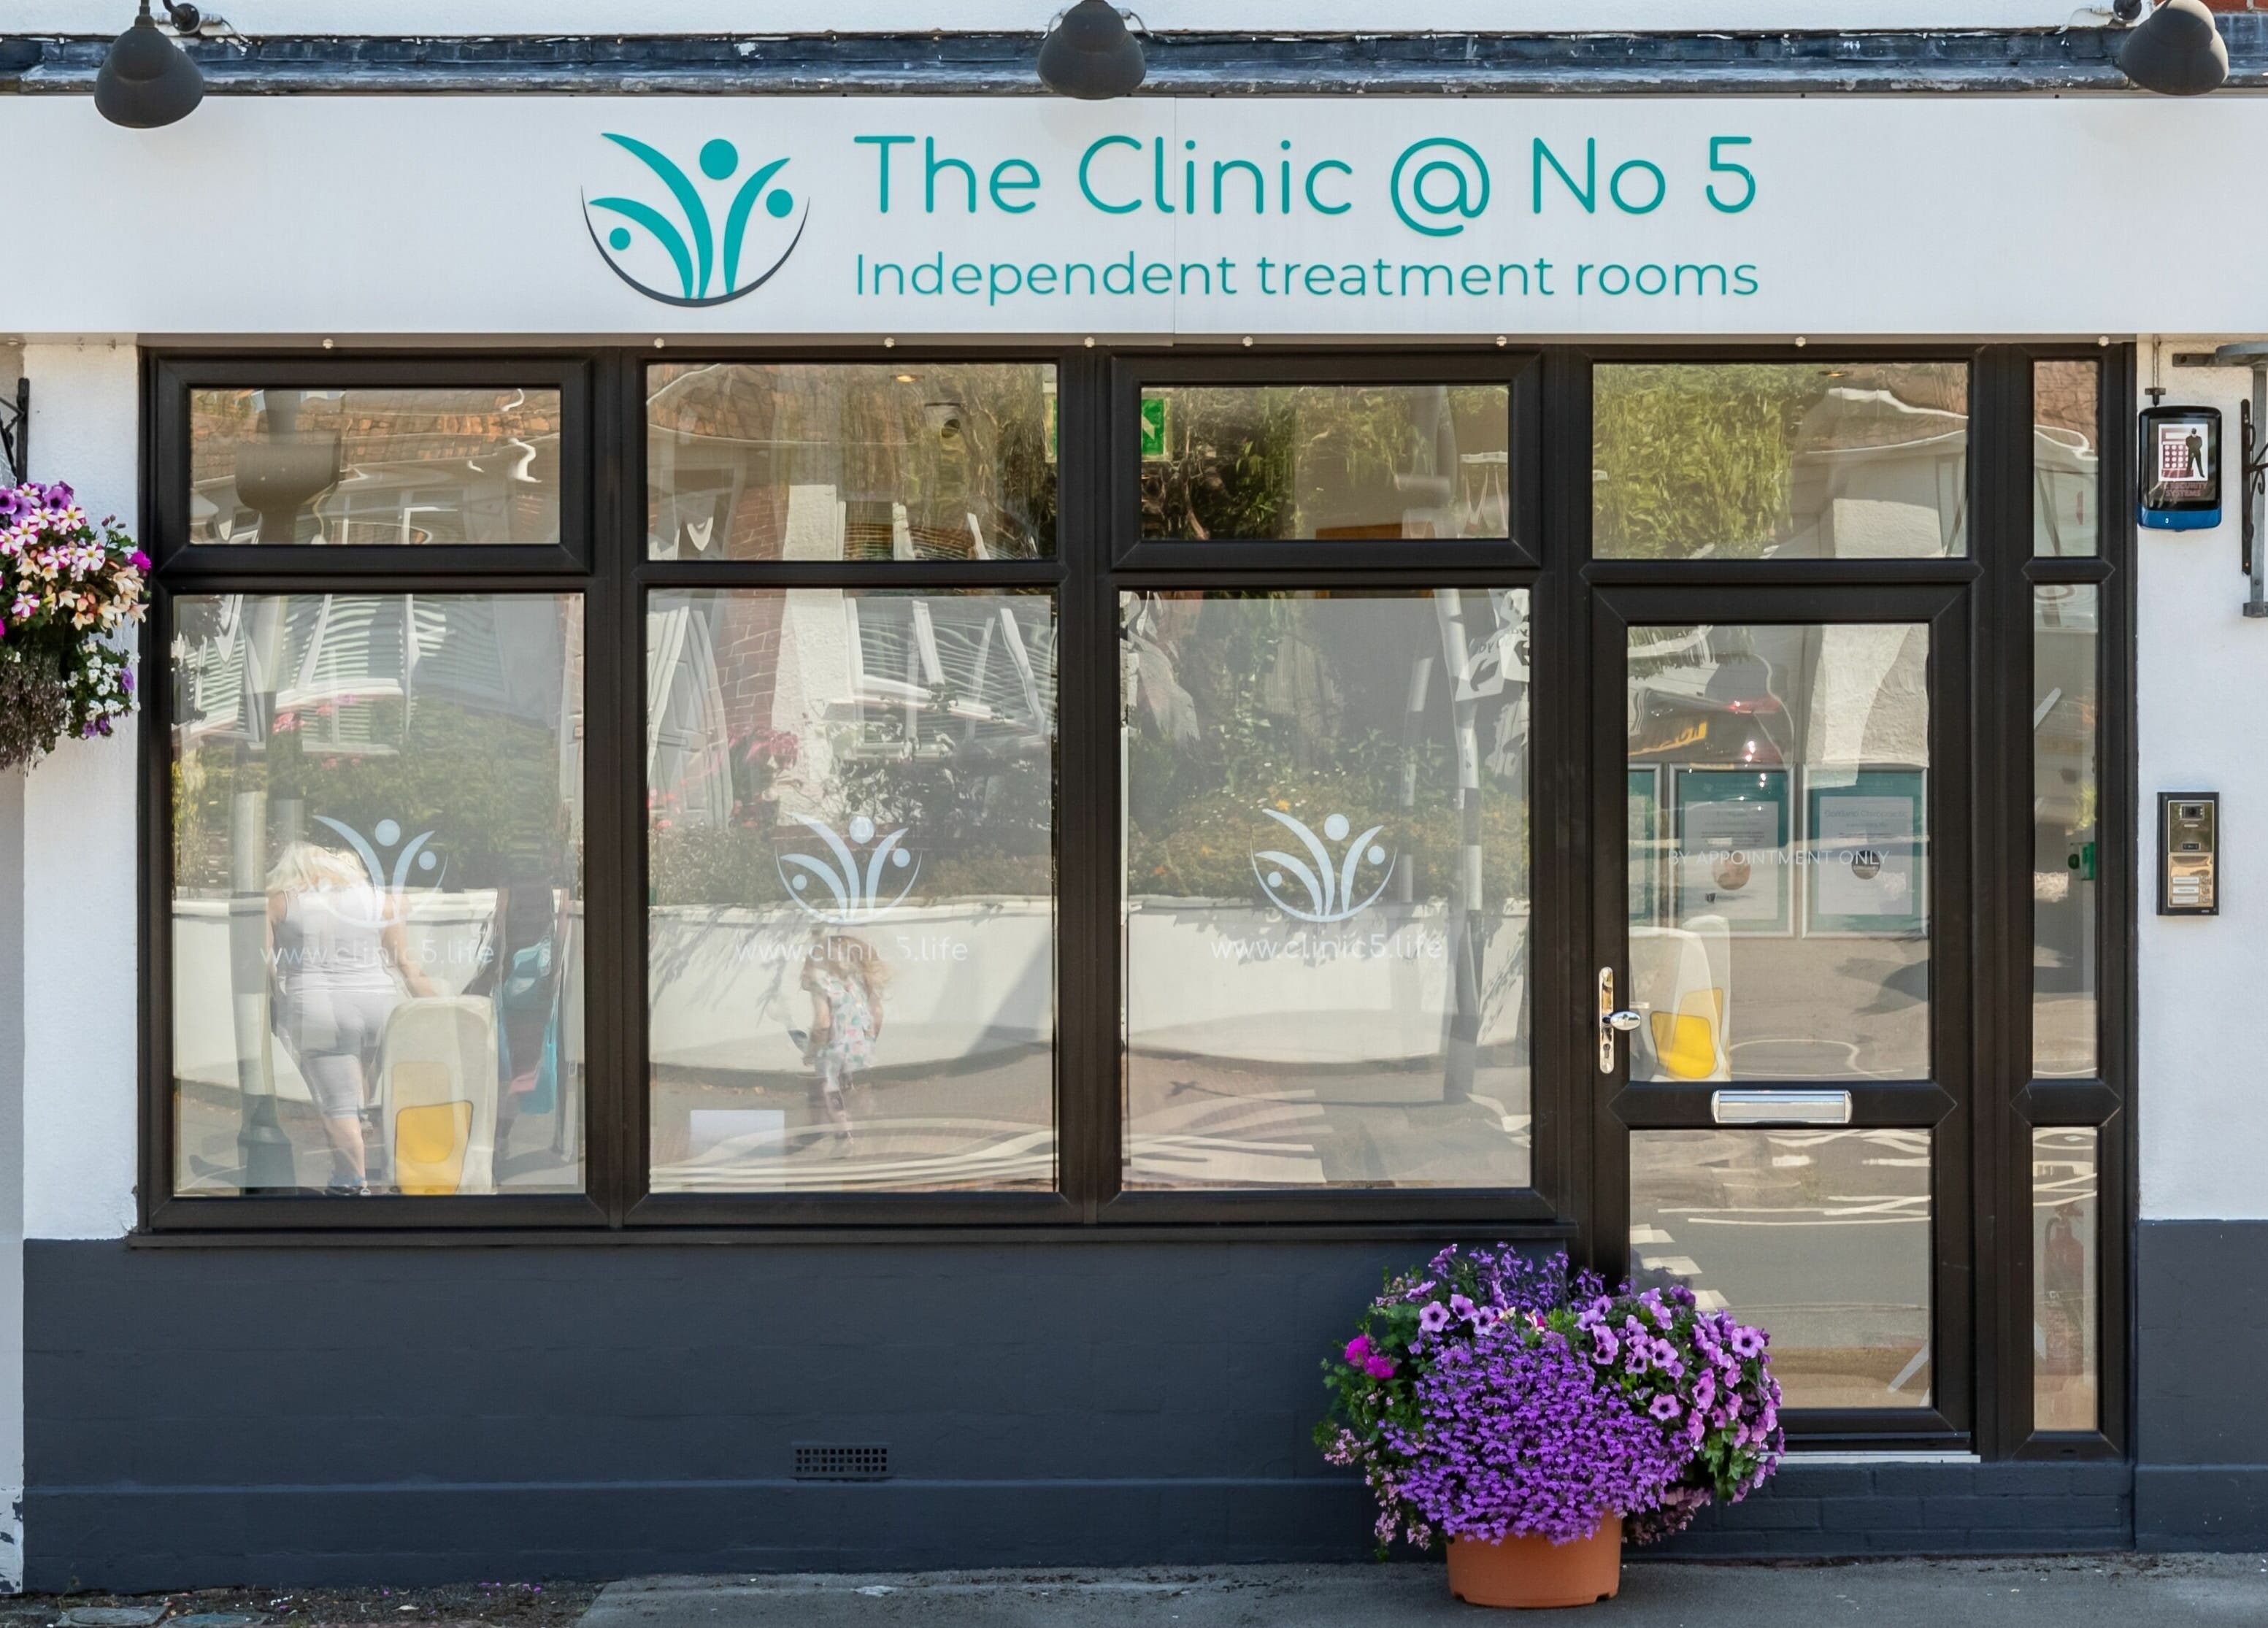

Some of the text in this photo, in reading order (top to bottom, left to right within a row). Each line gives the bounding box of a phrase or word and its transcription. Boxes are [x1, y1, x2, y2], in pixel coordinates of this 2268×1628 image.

[854, 135, 1758, 238] The Clinic @ No 5
[857, 251, 1760, 307] Independent treatment rooms
[1668, 850, 1890, 866] BY APPOINTMENT ONLY
[259, 939, 494, 964] www.clinic5.life
[1210, 933, 1443, 958] www.clinic5.life
